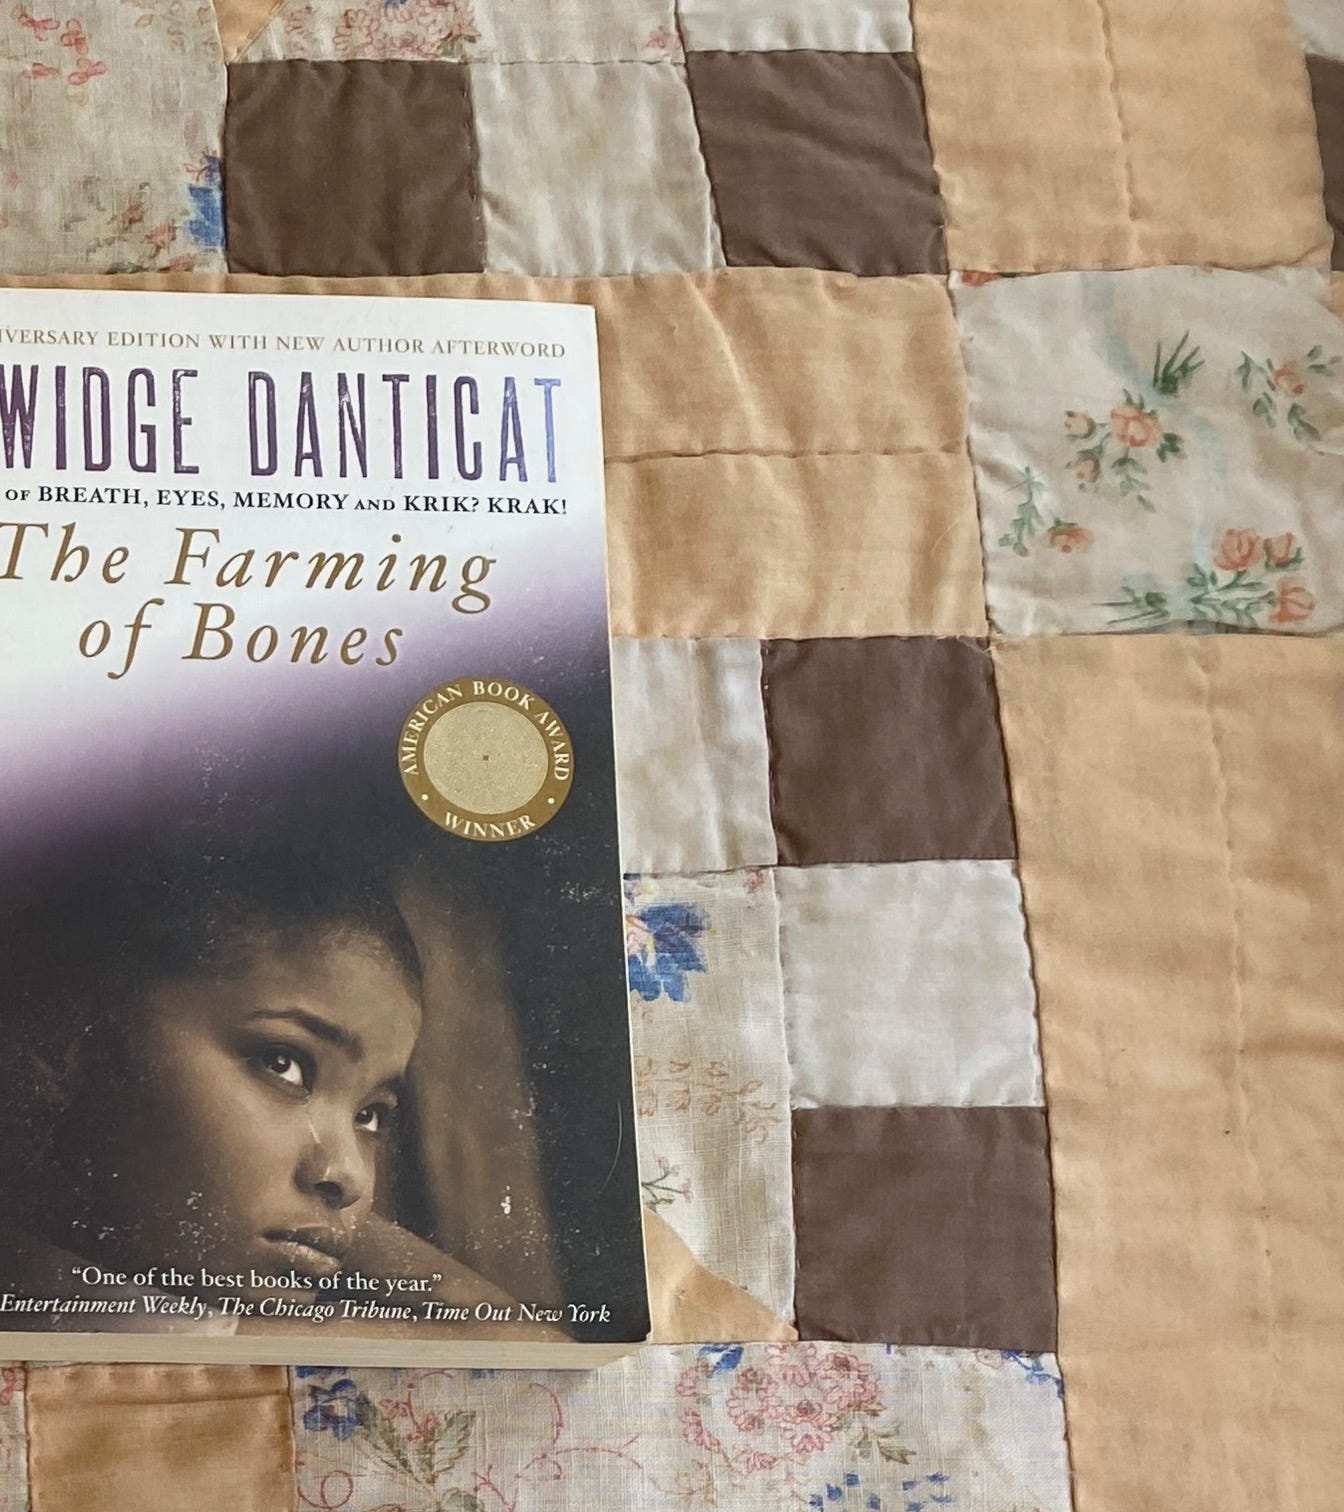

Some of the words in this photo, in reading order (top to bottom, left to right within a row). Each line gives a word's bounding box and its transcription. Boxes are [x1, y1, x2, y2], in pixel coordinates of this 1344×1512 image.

[108, 331, 200, 349] EDITION
[208, 333, 267, 351] WITH
[276, 335, 325, 351] NEW
[333, 337, 424, 354] AUTHOR
[431, 339, 566, 358] AFTERWORD
[248, 371, 563, 483] DANTICAT
[38, 485, 149, 509] BREATH,
[156, 488, 225, 510] EYES,
[232, 491, 350, 510] MEMORY
[403, 494, 480, 513] KRIK?
[487, 496, 568, 515] KRAK!
[164, 526, 498, 615] Farming
[77, 597, 165, 681] of
[181, 601, 405, 667] Bones
[401, 683, 463, 776] AMERICAN
[471, 680, 535, 711] BOOK
[534, 711, 570, 781] AWARD
[445, 811, 536, 838] WINNER
[71, 1266, 127, 1286] “One
[133, 1267, 158, 1286] of
[161, 1268, 194, 1287] the
[201, 1269, 244, 1288] best
[250, 1270, 313, 1290] books
[318, 1270, 340, 1290] of
[347, 1272, 379, 1291] the
[384, 1273, 442, 1297] year.”
[0, 1294, 136, 1314] Entertainment
[142, 1295, 214, 1320] Weekly,
[218, 1296, 255, 1317] The
[259, 1297, 335, 1324] Chicago
[339, 1299, 418, 1323] Tribune,
[422, 1300, 470, 1322] Time
[474, 1302, 514, 1323] Out
[517, 1303, 563, 1323] New
[566, 1303, 612, 1324] York
